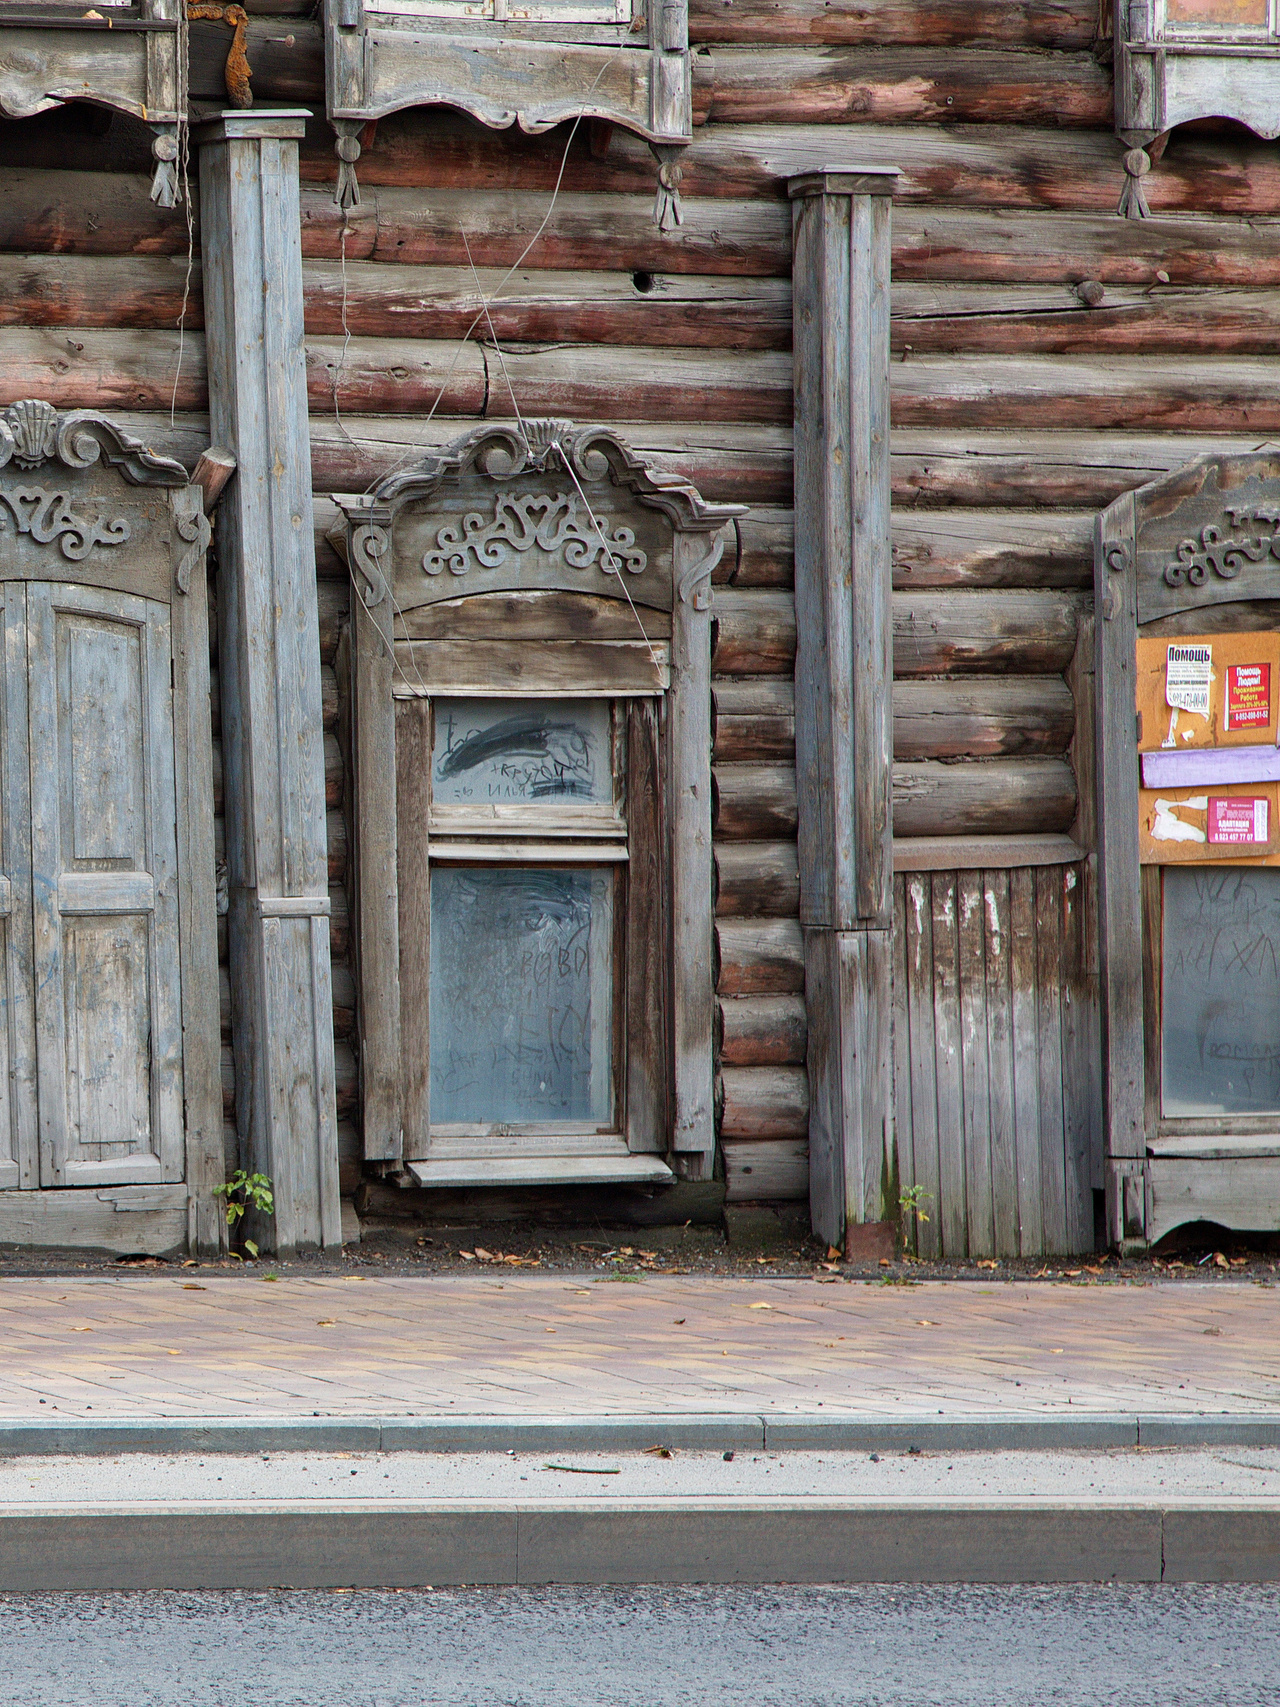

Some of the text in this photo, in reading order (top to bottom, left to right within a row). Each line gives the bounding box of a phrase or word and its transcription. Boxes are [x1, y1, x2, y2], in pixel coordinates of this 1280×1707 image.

[1169, 647, 1210, 664] Помощь
[1237, 667, 1261, 677] Помощь
[1238, 675, 1260, 686] Людям!
[1233, 686, 1265, 694] Проживание
[1218, 820, 1250, 828] АДАПТАЦИЯ
